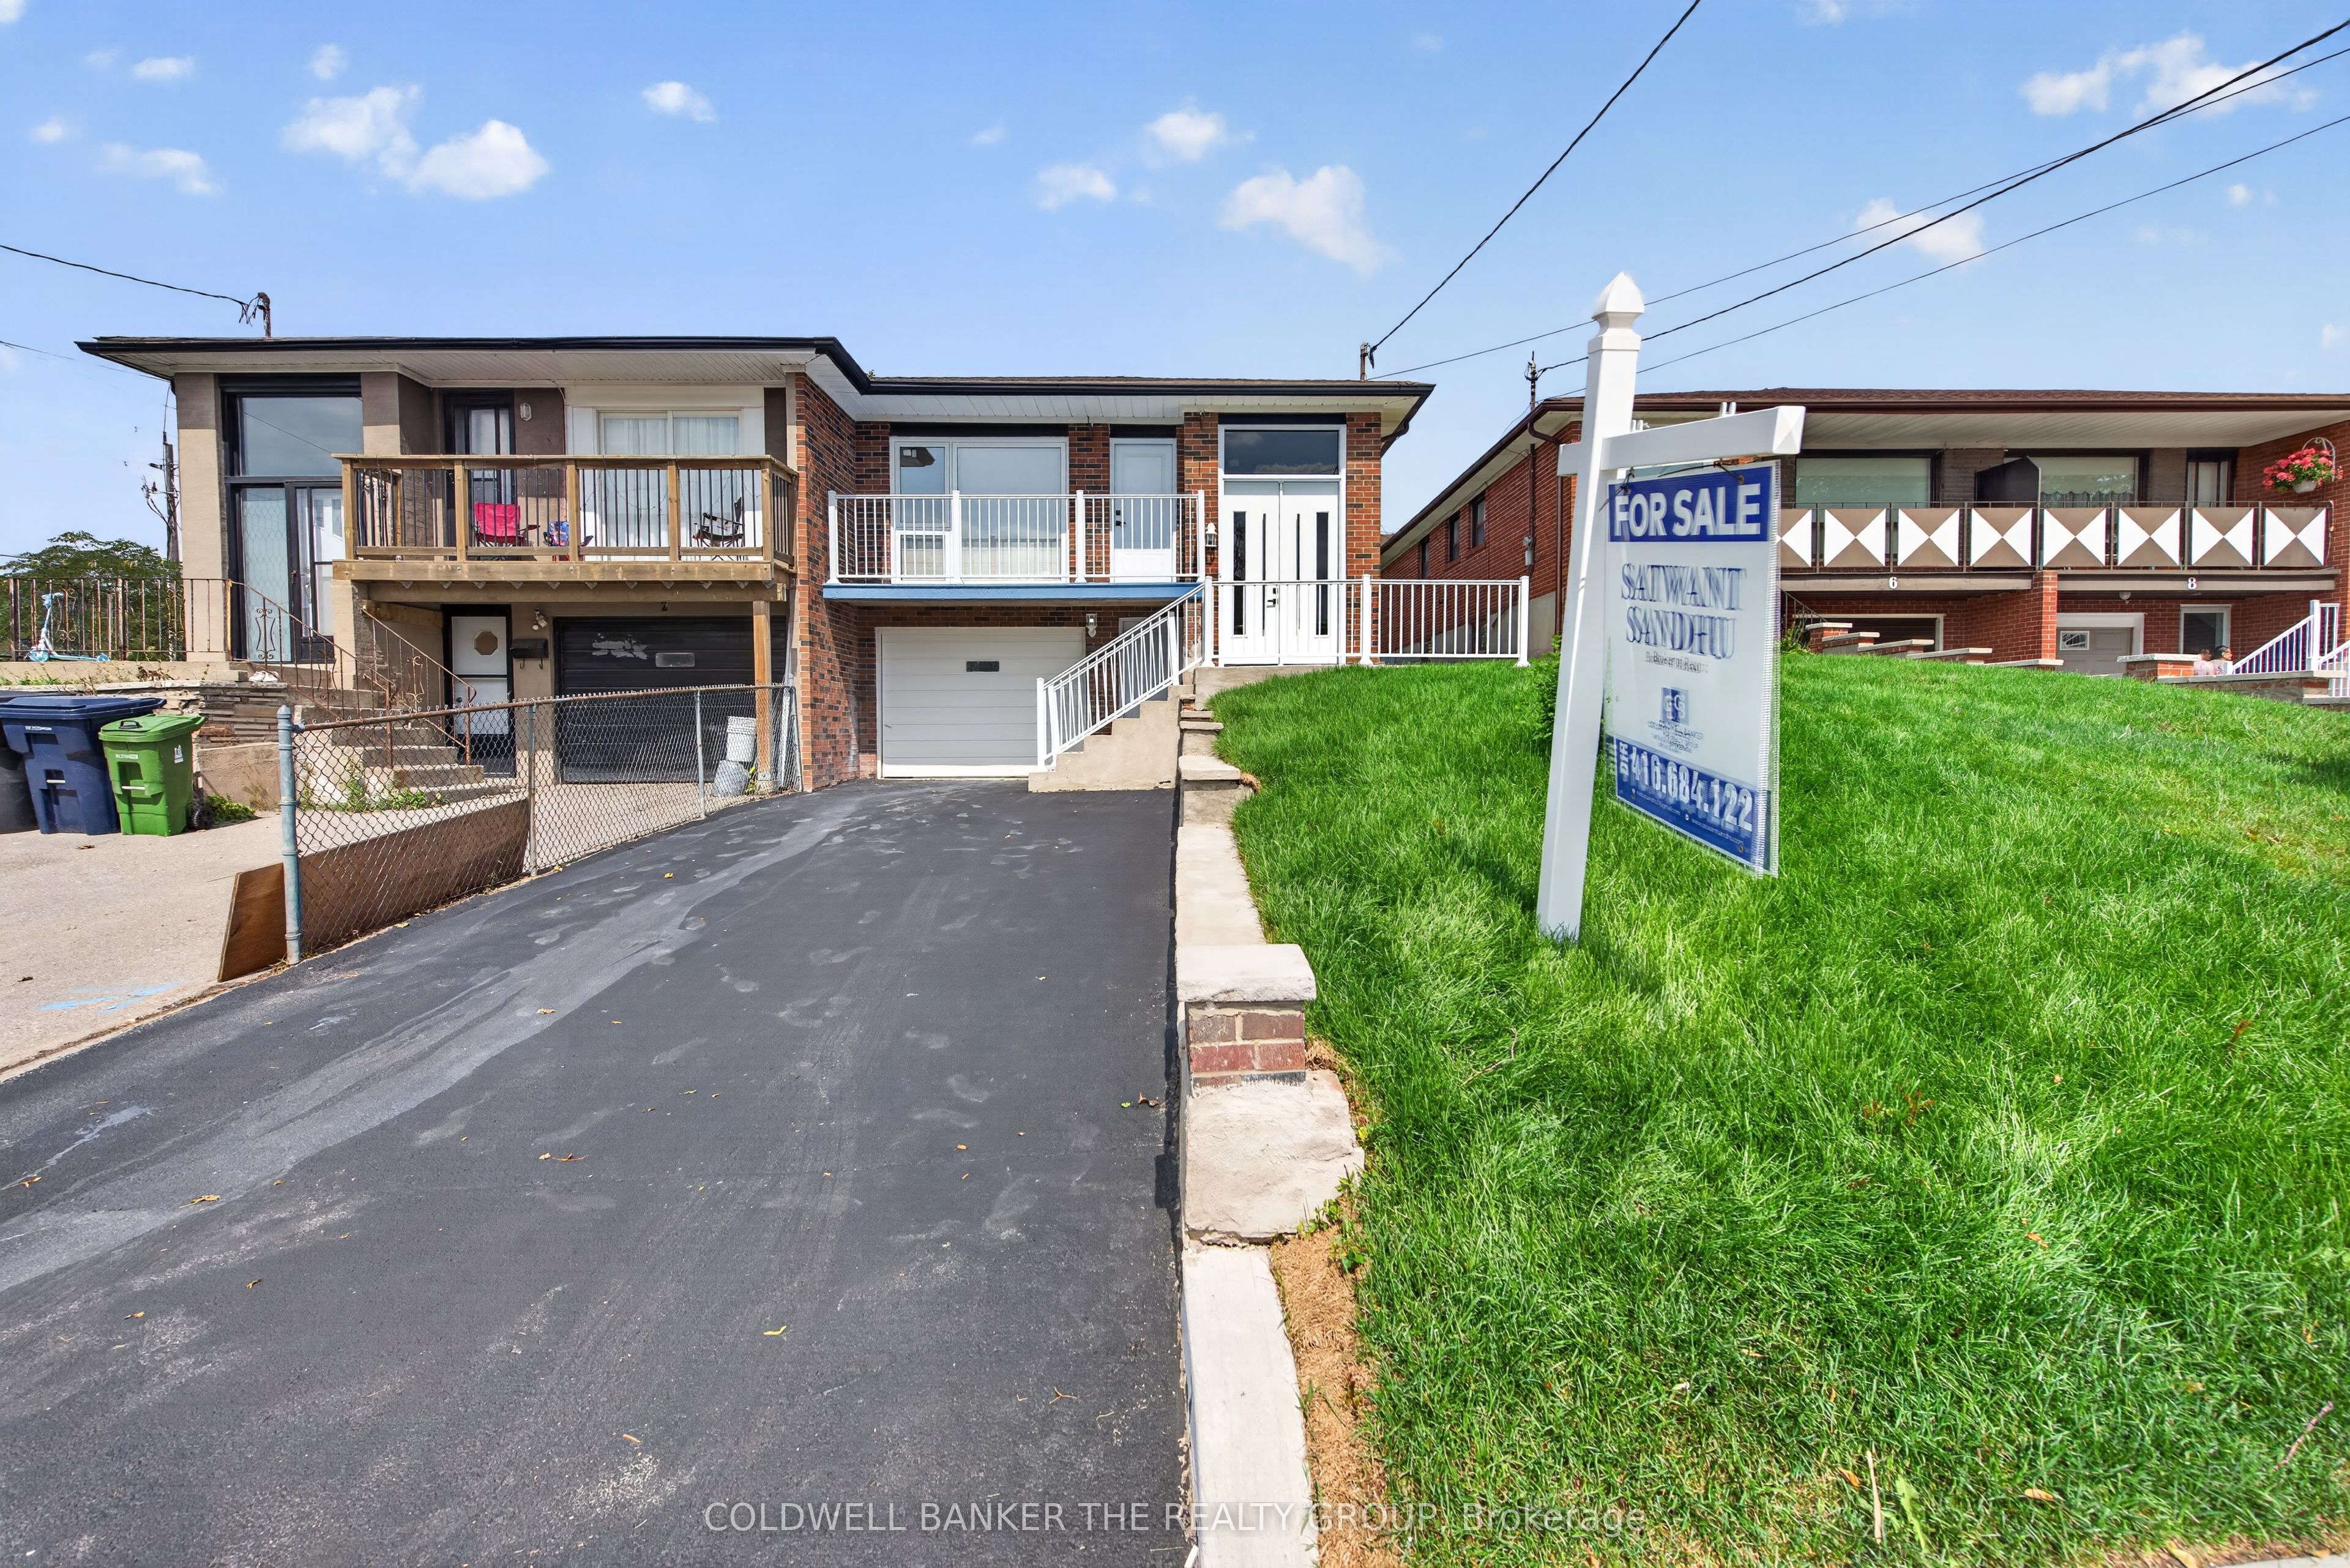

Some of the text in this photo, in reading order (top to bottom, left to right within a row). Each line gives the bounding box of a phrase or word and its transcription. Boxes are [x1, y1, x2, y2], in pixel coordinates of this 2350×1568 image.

[1614, 483, 1761, 537] FOR SALE
[1889, 576, 1897, 589] 6
[2188, 577, 2197, 589] 8
[1626, 606, 1737, 660] SANDHU
